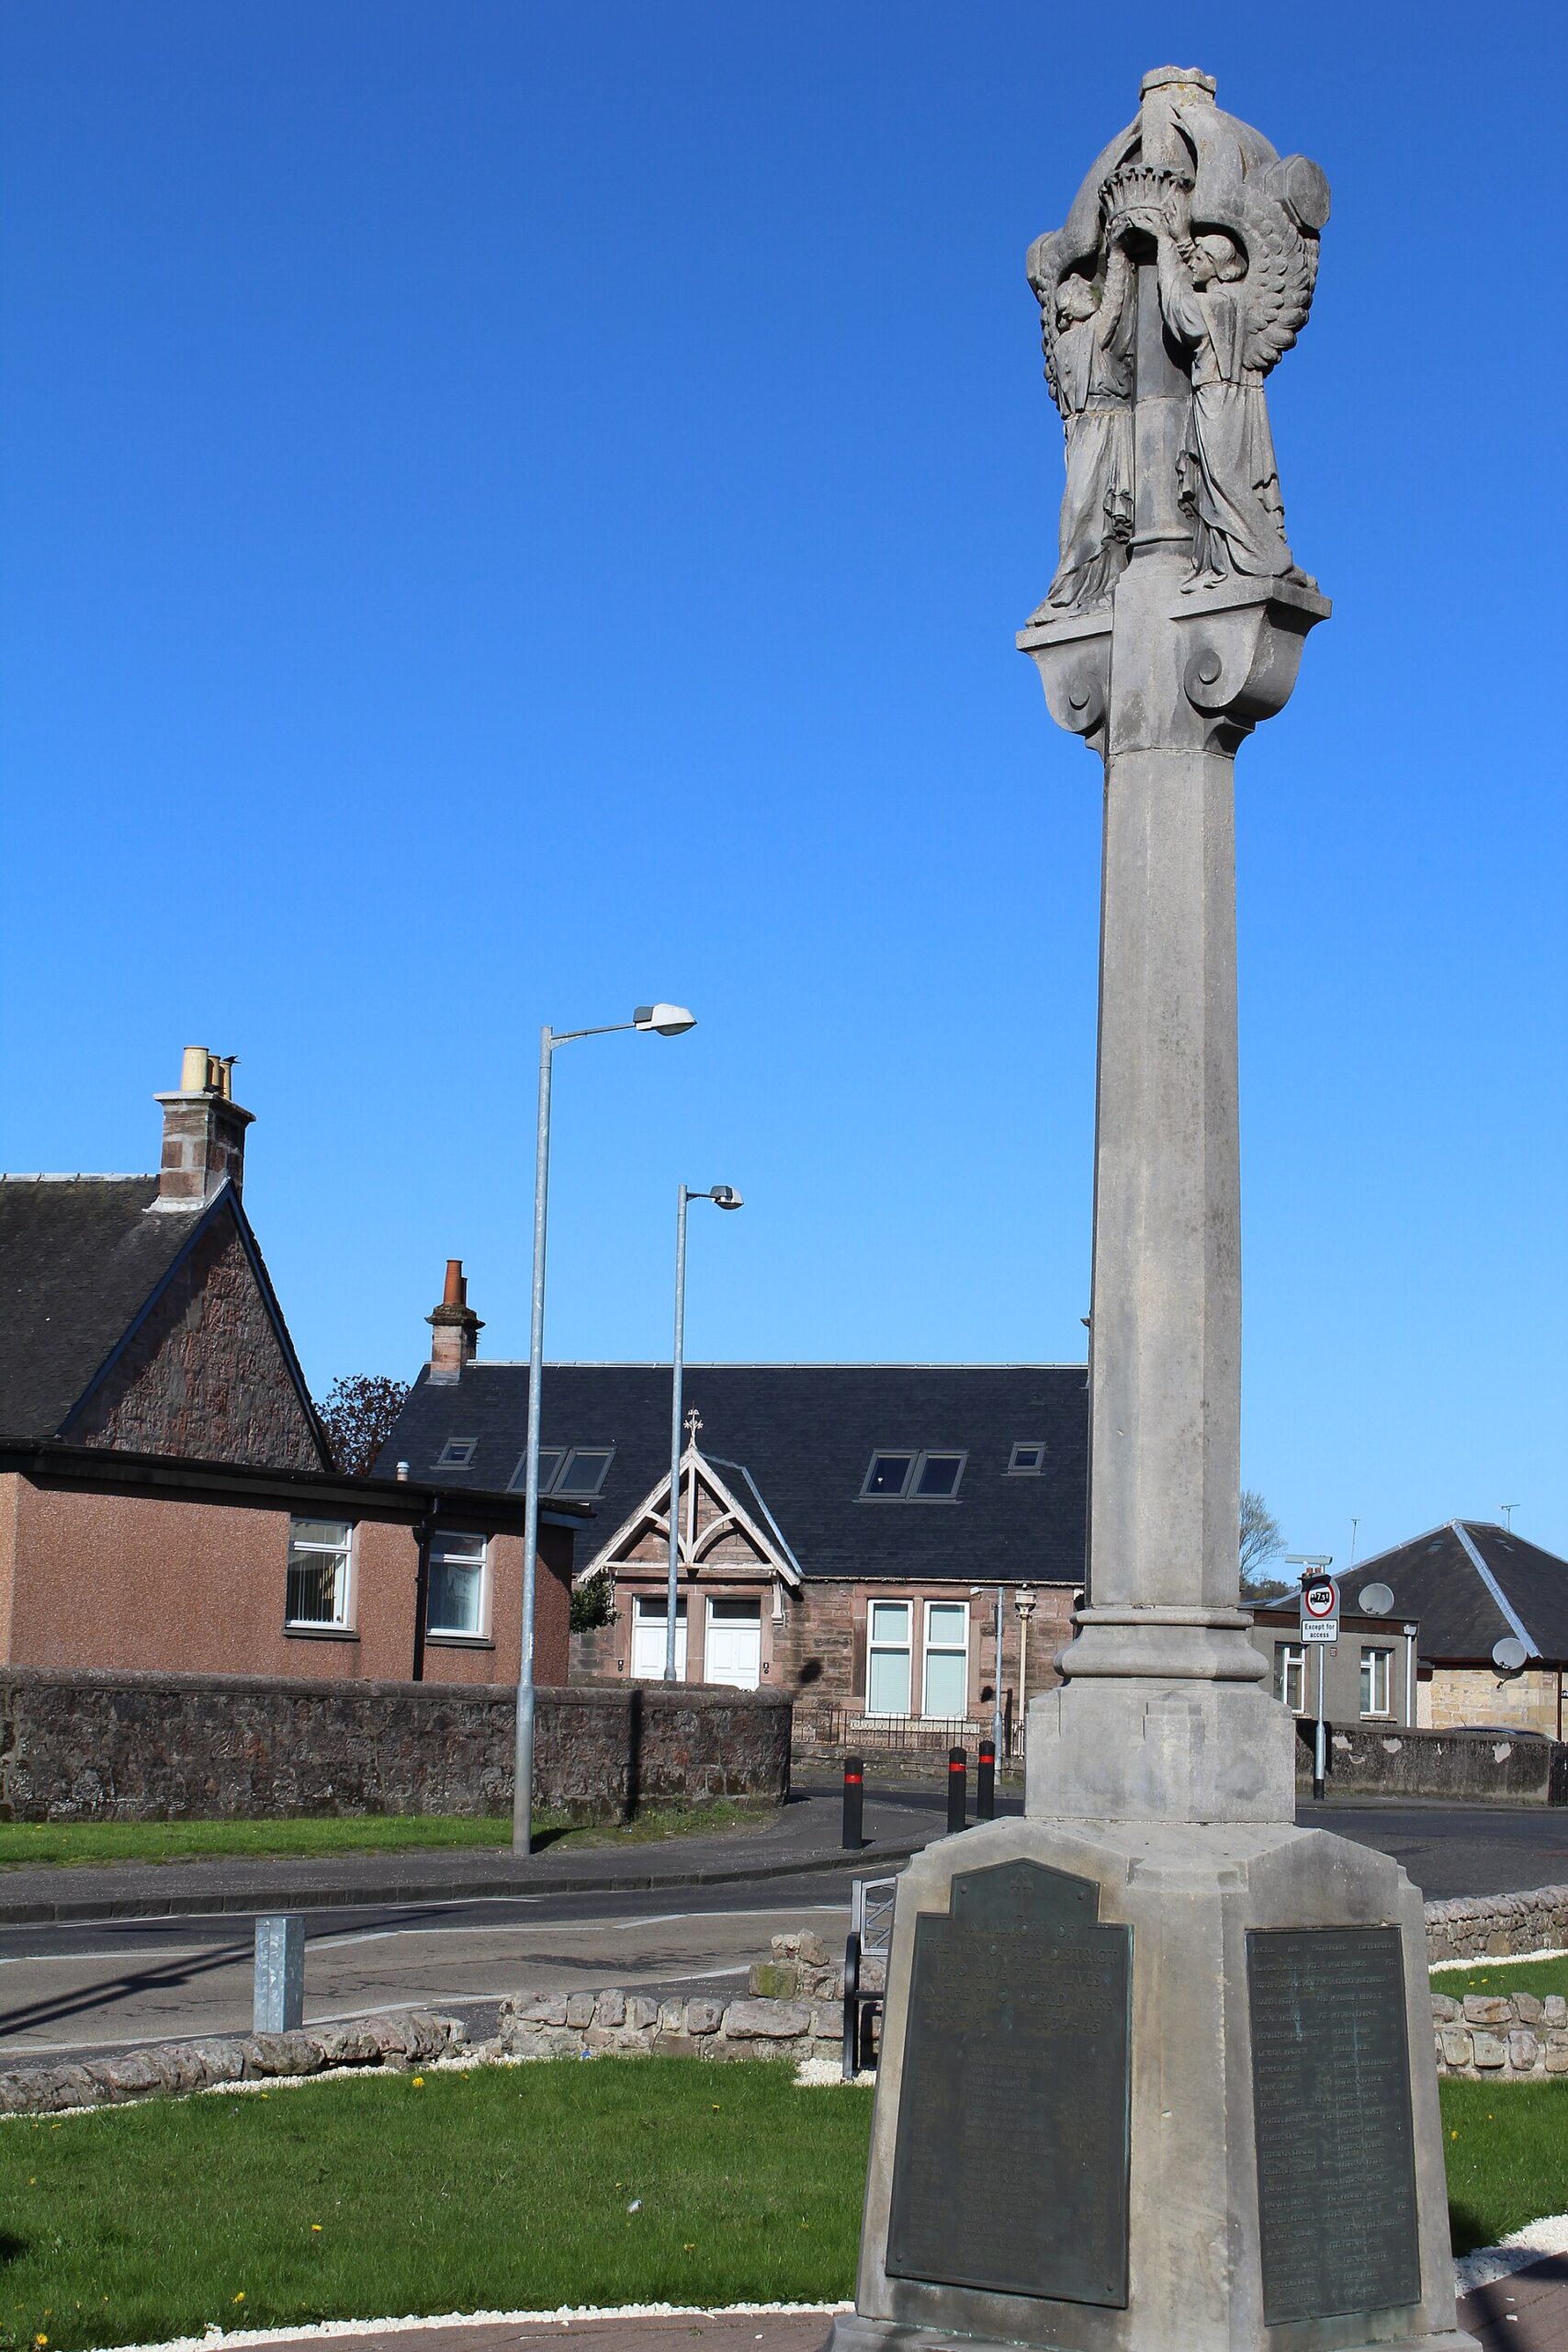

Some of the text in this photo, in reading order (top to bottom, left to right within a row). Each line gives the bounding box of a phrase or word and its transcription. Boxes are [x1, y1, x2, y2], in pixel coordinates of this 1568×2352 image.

[1057, 1923, 1076, 1939] OF
[924, 1938, 950, 1954] THE
[954, 1940, 982, 1956] MEN
[1011, 1944, 1043, 1960] THIS
[1051, 1947, 1118, 1964] DISTRICT
[936, 1964, 1101, 1987] WHO GAVE THEIR LIVES
[942, 1984, 971, 2001] THE
